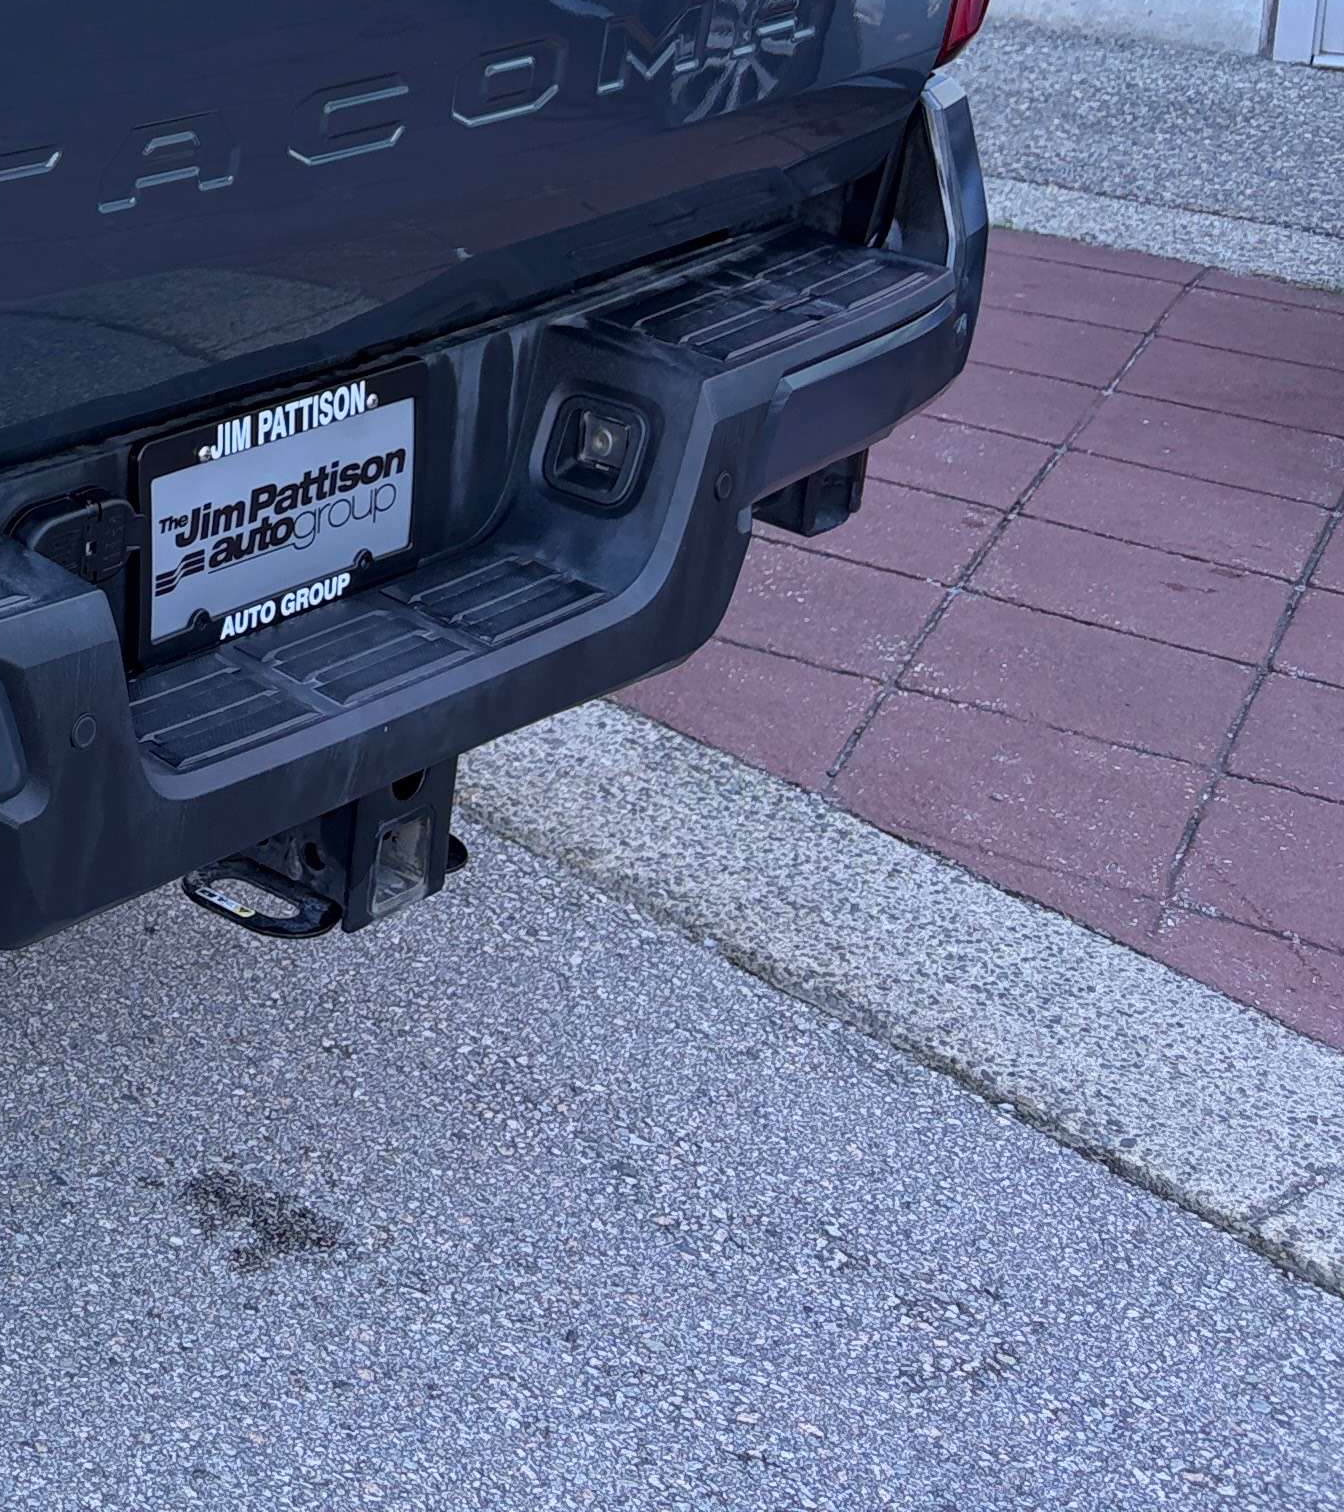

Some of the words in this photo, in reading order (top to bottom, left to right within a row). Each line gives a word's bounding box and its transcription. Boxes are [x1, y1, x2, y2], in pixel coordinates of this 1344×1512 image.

[210, 415, 251, 460] JIM
[257, 380, 367, 444] PATTISON
[159, 514, 188, 534] The
[219, 600, 276, 641] AUTO
[280, 572, 351, 617] GROUP
